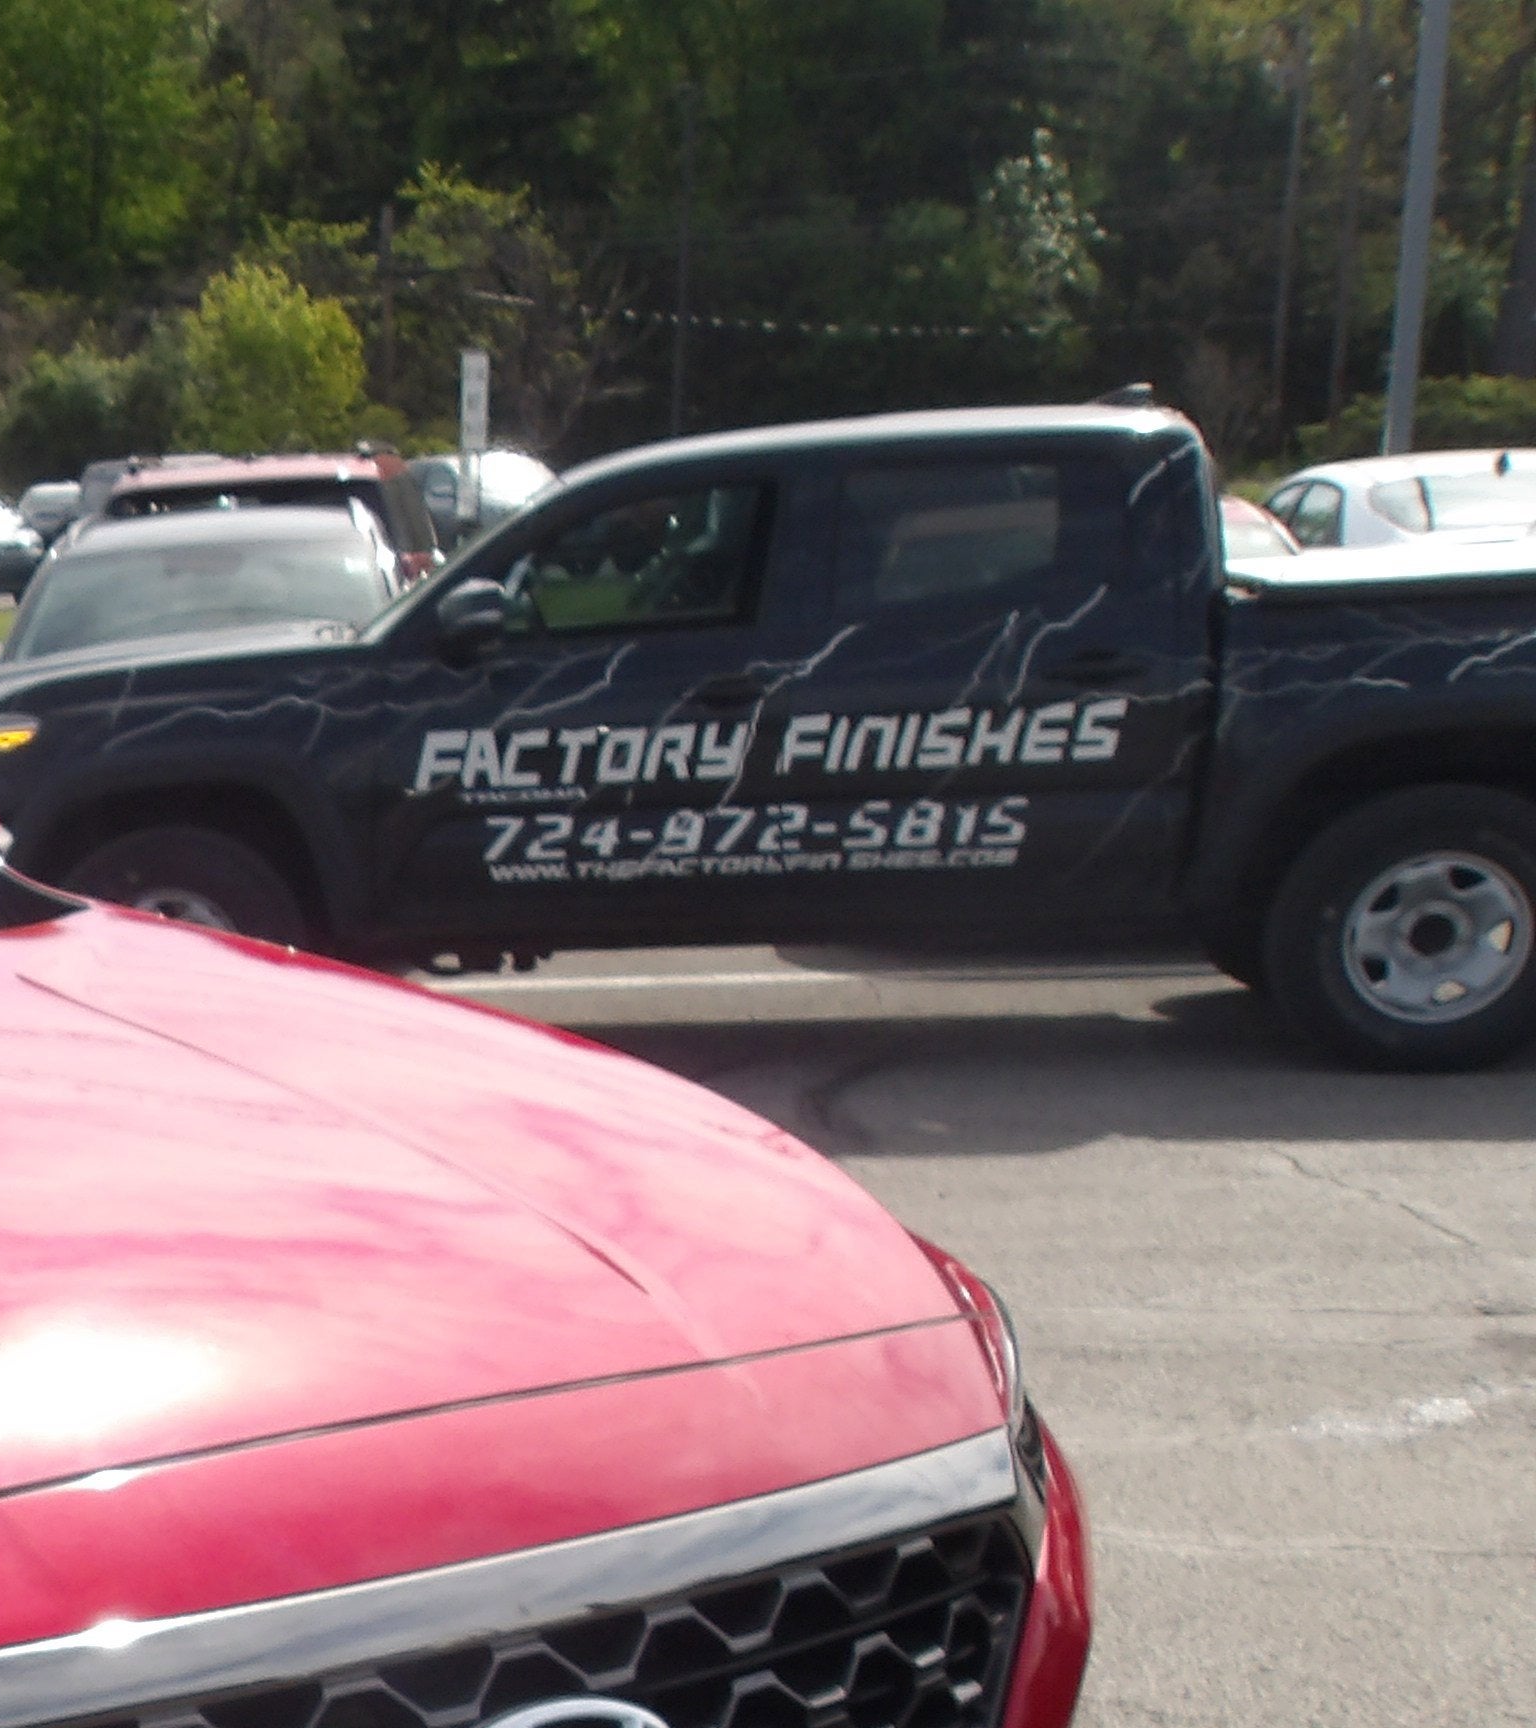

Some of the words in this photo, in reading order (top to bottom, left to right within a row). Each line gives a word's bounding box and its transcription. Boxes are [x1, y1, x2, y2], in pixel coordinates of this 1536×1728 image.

[415, 721, 750, 791] FACTORY
[776, 697, 1128, 773] FINISHES
[483, 796, 1029, 862] 724-972-5815
